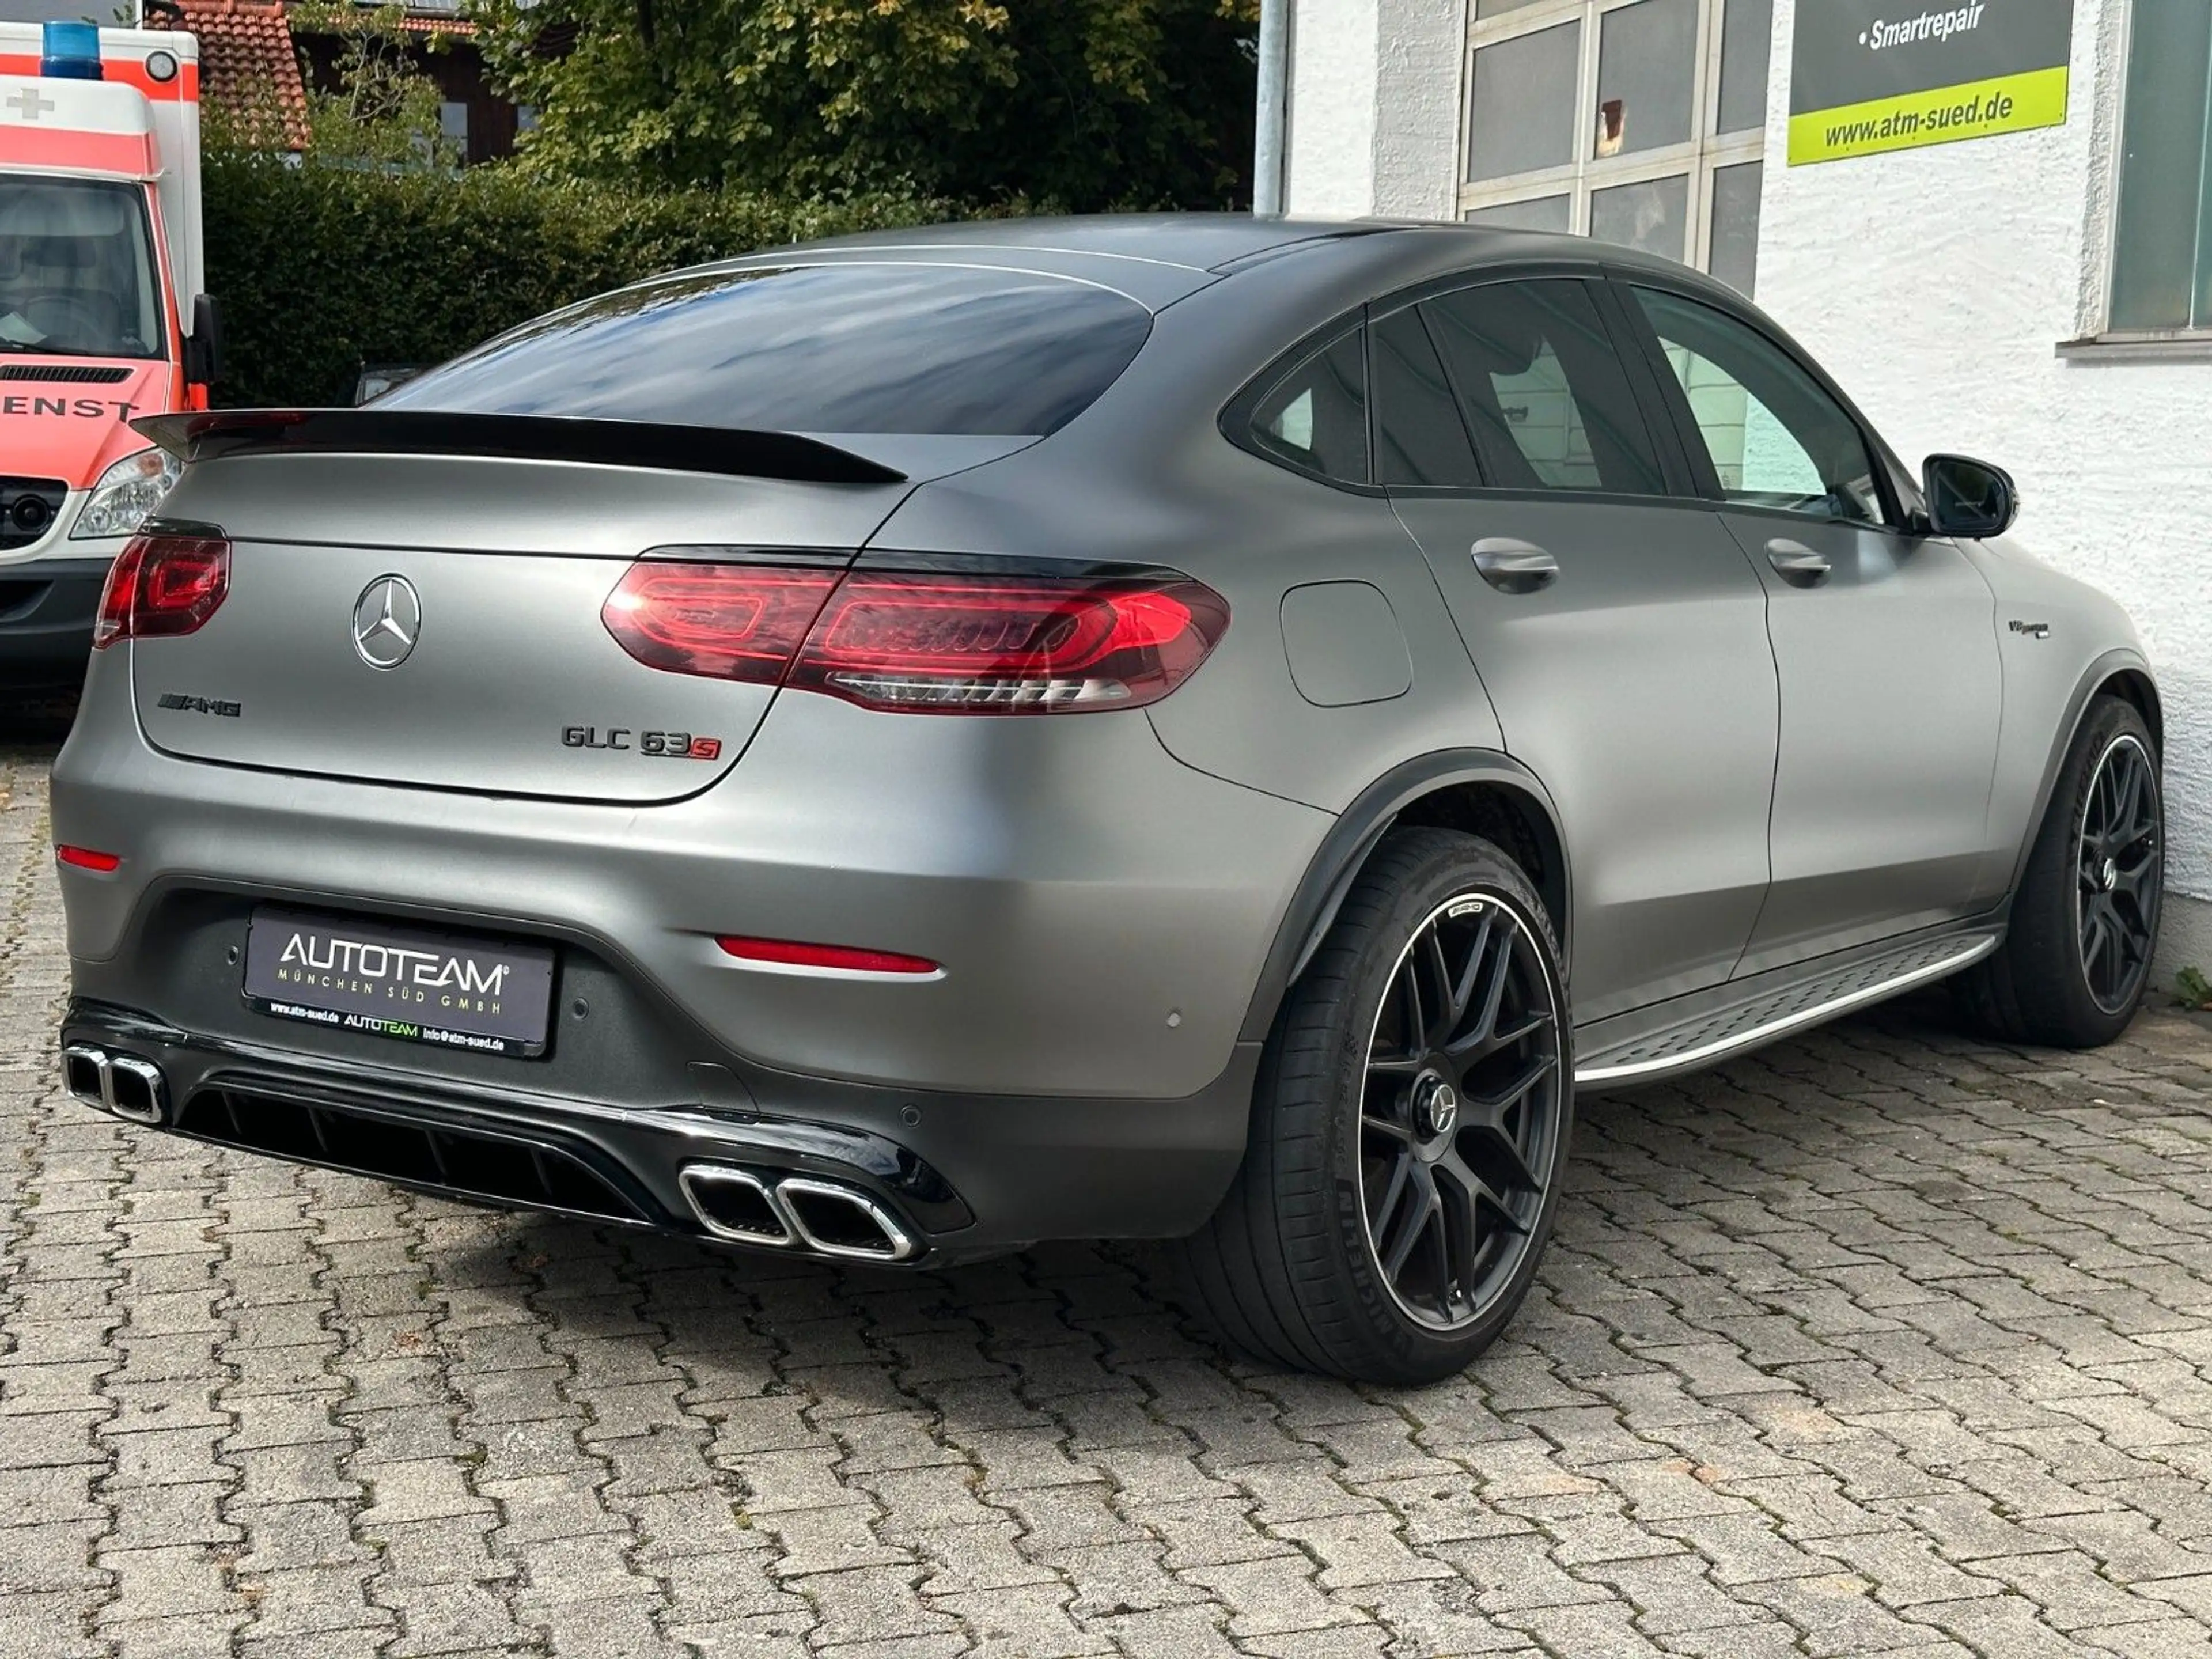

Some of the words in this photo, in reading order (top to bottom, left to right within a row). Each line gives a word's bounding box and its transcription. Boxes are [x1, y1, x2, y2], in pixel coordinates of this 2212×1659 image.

[1870, 0, 1985, 50] Smartrepair
[1825, 91, 2013, 147] www.atm-sued.de
[561, 726, 631, 750] GLC
[278, 968, 373, 994] MÜNCHEN
[387, 986, 425, 1002] SÜD
[441, 995, 501, 1015] GMBH
[271, 1002, 339, 1023] www.atm-sued.de
[344, 1014, 418, 1037] AUTOTEAM
